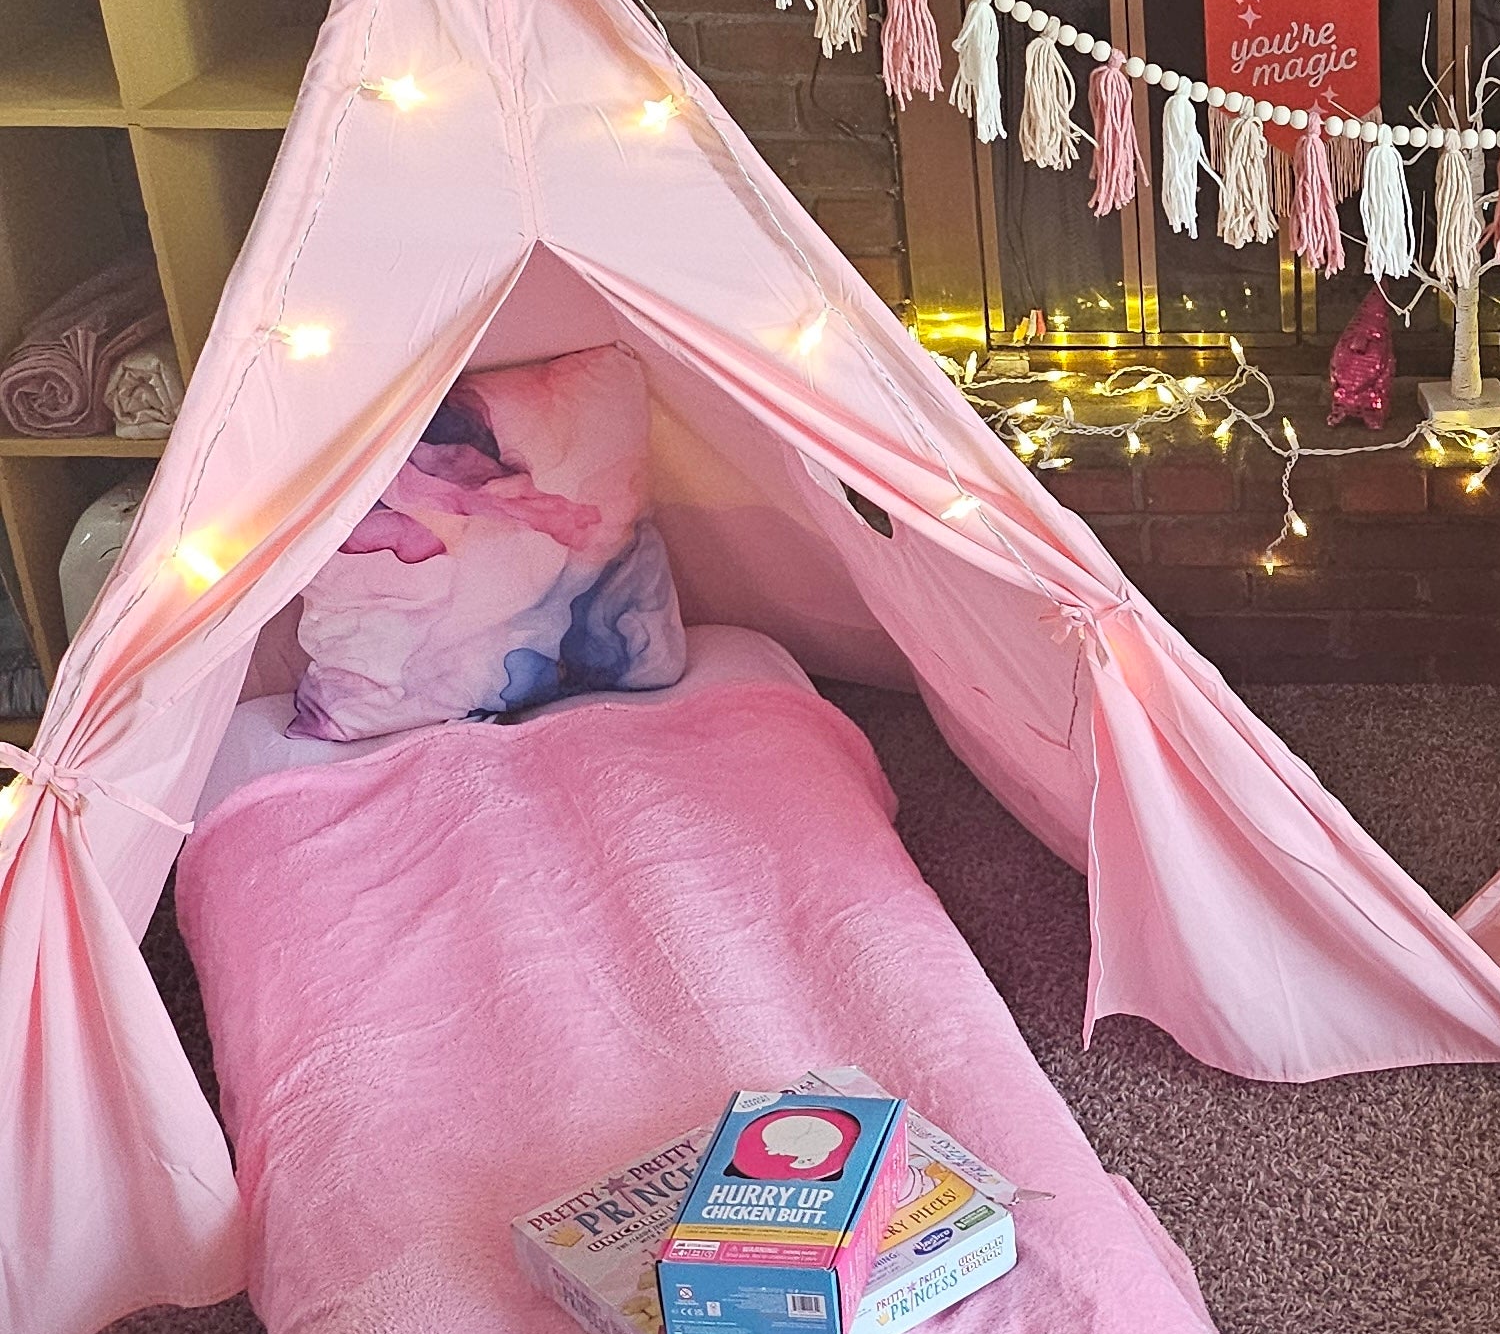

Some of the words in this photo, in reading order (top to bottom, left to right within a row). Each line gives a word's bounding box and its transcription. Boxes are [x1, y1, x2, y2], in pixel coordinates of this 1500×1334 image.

[1230, 21, 1337, 74] you're
[1252, 44, 1358, 88] magic
[527, 1186, 602, 1232] PRETTY
[627, 1139, 699, 1181] PRETTY
[706, 1184, 797, 1207] HURRY
[797, 1187, 835, 1210] UP
[701, 1205, 777, 1223] CHICKEN
[777, 1208, 826, 1225] BUTT
[909, 1188, 957, 1224] PIECES!
[587, 1210, 668, 1253] UNICORN
[914, 1228, 951, 1252] Hasbro
[958, 1235, 1005, 1267] UNICORN
[961, 1247, 1004, 1276] EDITION
[890, 1269, 959, 1321] PRINCESS
